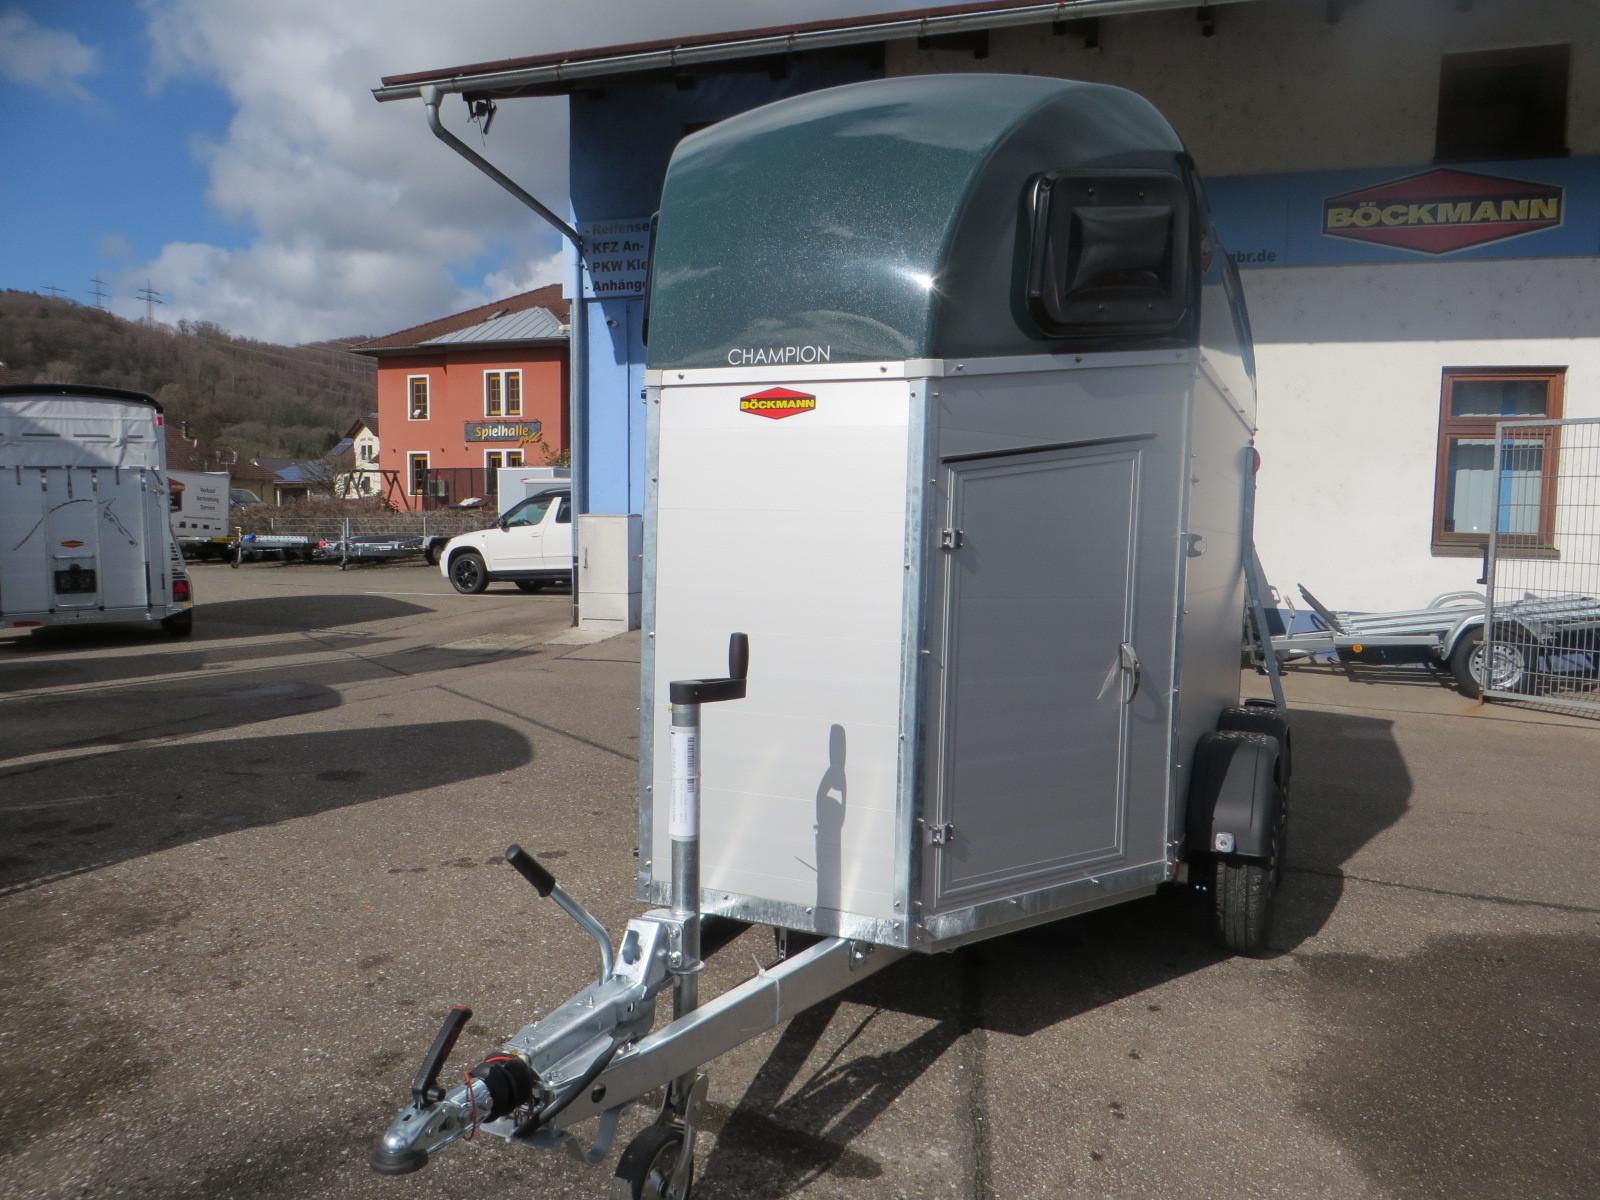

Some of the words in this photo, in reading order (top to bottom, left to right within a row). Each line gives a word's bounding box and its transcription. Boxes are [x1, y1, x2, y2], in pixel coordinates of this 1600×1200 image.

[1327, 197, 1559, 229] BÖCKMANN
[593, 241, 618, 253] KFZ
[593, 260, 622, 272] PKW
[593, 279, 645, 292] Anhäng
[728, 345, 831, 365] CHAMPION
[741, 398, 815, 410] BÖCKMANN
[475, 425, 528, 439] Spielhalle
